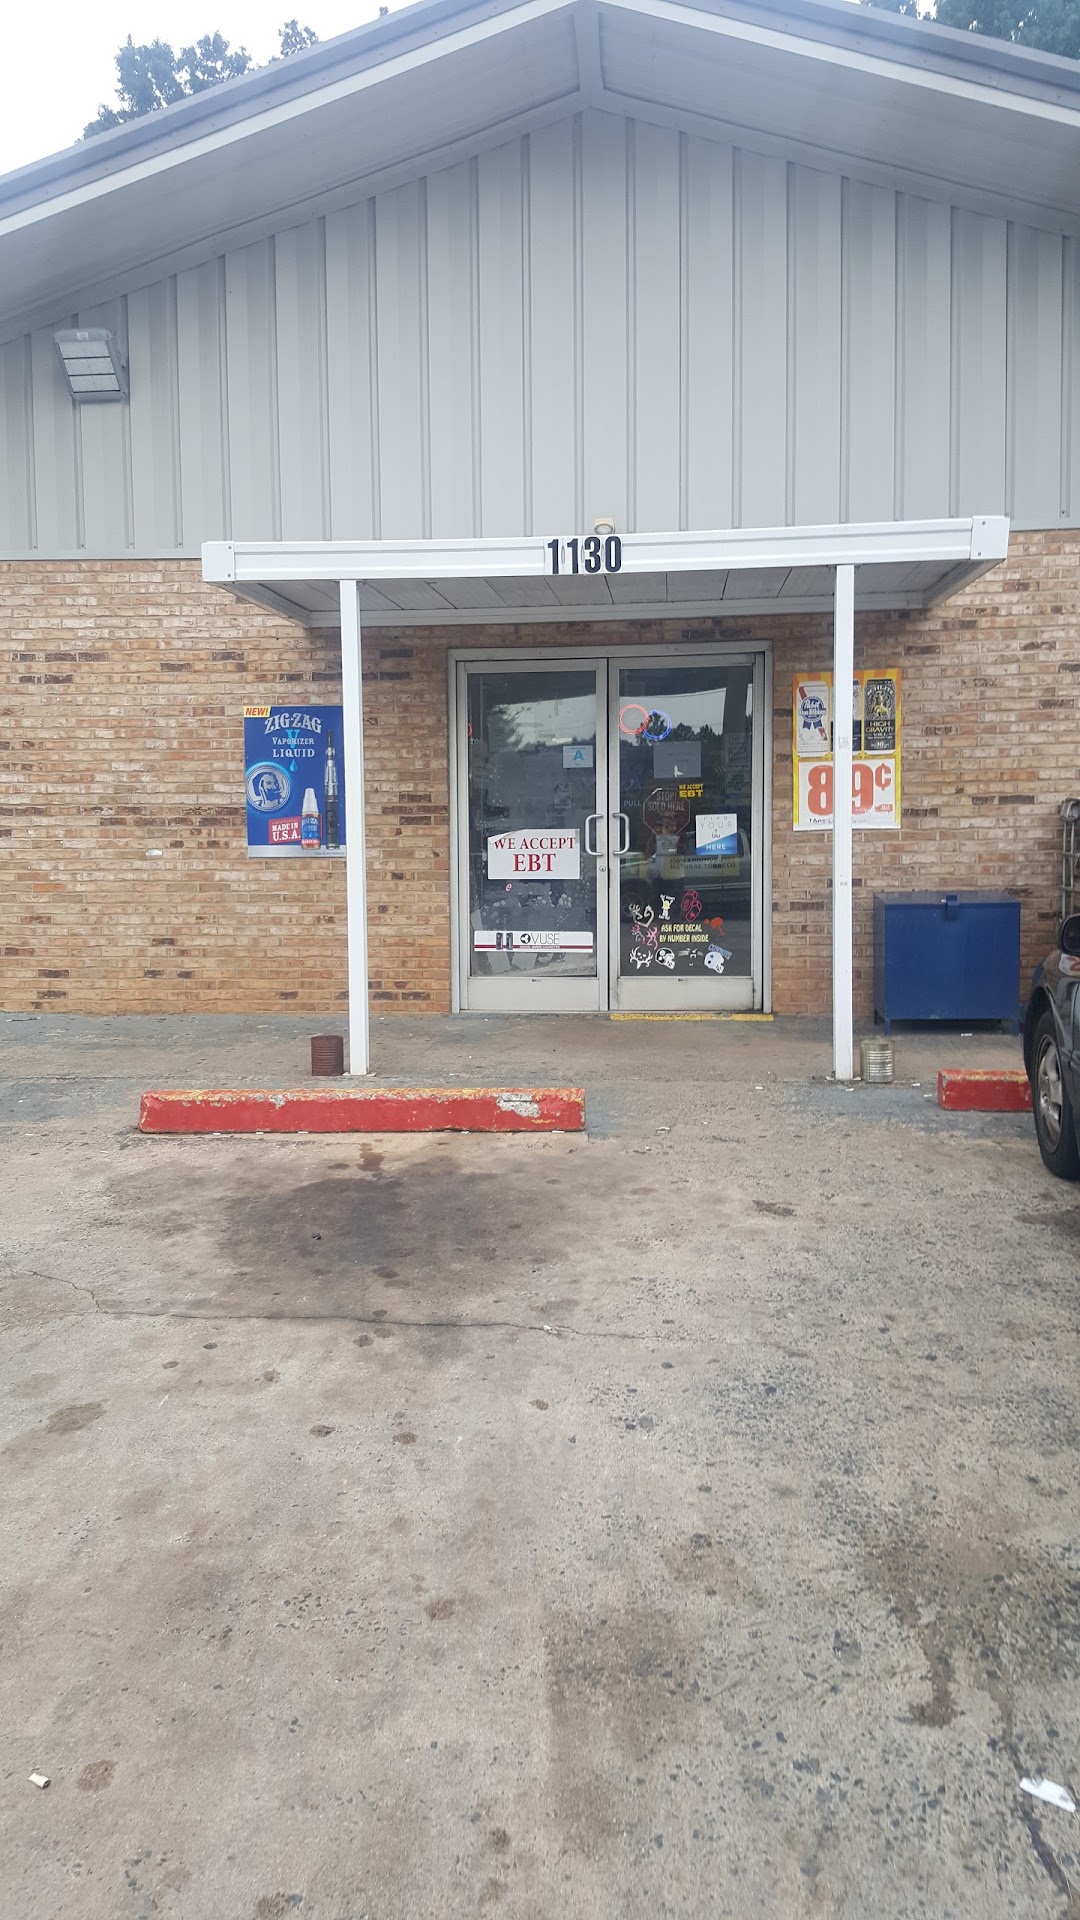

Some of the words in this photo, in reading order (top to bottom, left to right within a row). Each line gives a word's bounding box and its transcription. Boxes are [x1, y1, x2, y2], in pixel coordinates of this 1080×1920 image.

[547, 536, 621, 574] 1130
[245, 708, 269, 716] NEW!
[272, 737, 315, 745] VAPORIZER
[273, 749, 315, 758] LIQUID
[574, 750, 584, 761] A
[679, 790, 703, 798] EBT
[667, 801, 685, 811] HERE
[272, 823, 290, 832] MADE
[699, 821, 732, 829] YOUR
[272, 829, 302, 841] U.S.A.
[494, 838, 516, 850] WE
[519, 838, 576, 850] ACCEPT
[513, 853, 556, 872] EBT
[661, 924, 672, 932] ASK
[673, 924, 684, 932] FOR
[685, 924, 702, 932] DECAL
[531, 933, 561, 944] VUSE
[659, 934, 667, 942] BY
[668, 934, 690, 942] NUMBER
[691, 934, 709, 942] INSIDE
